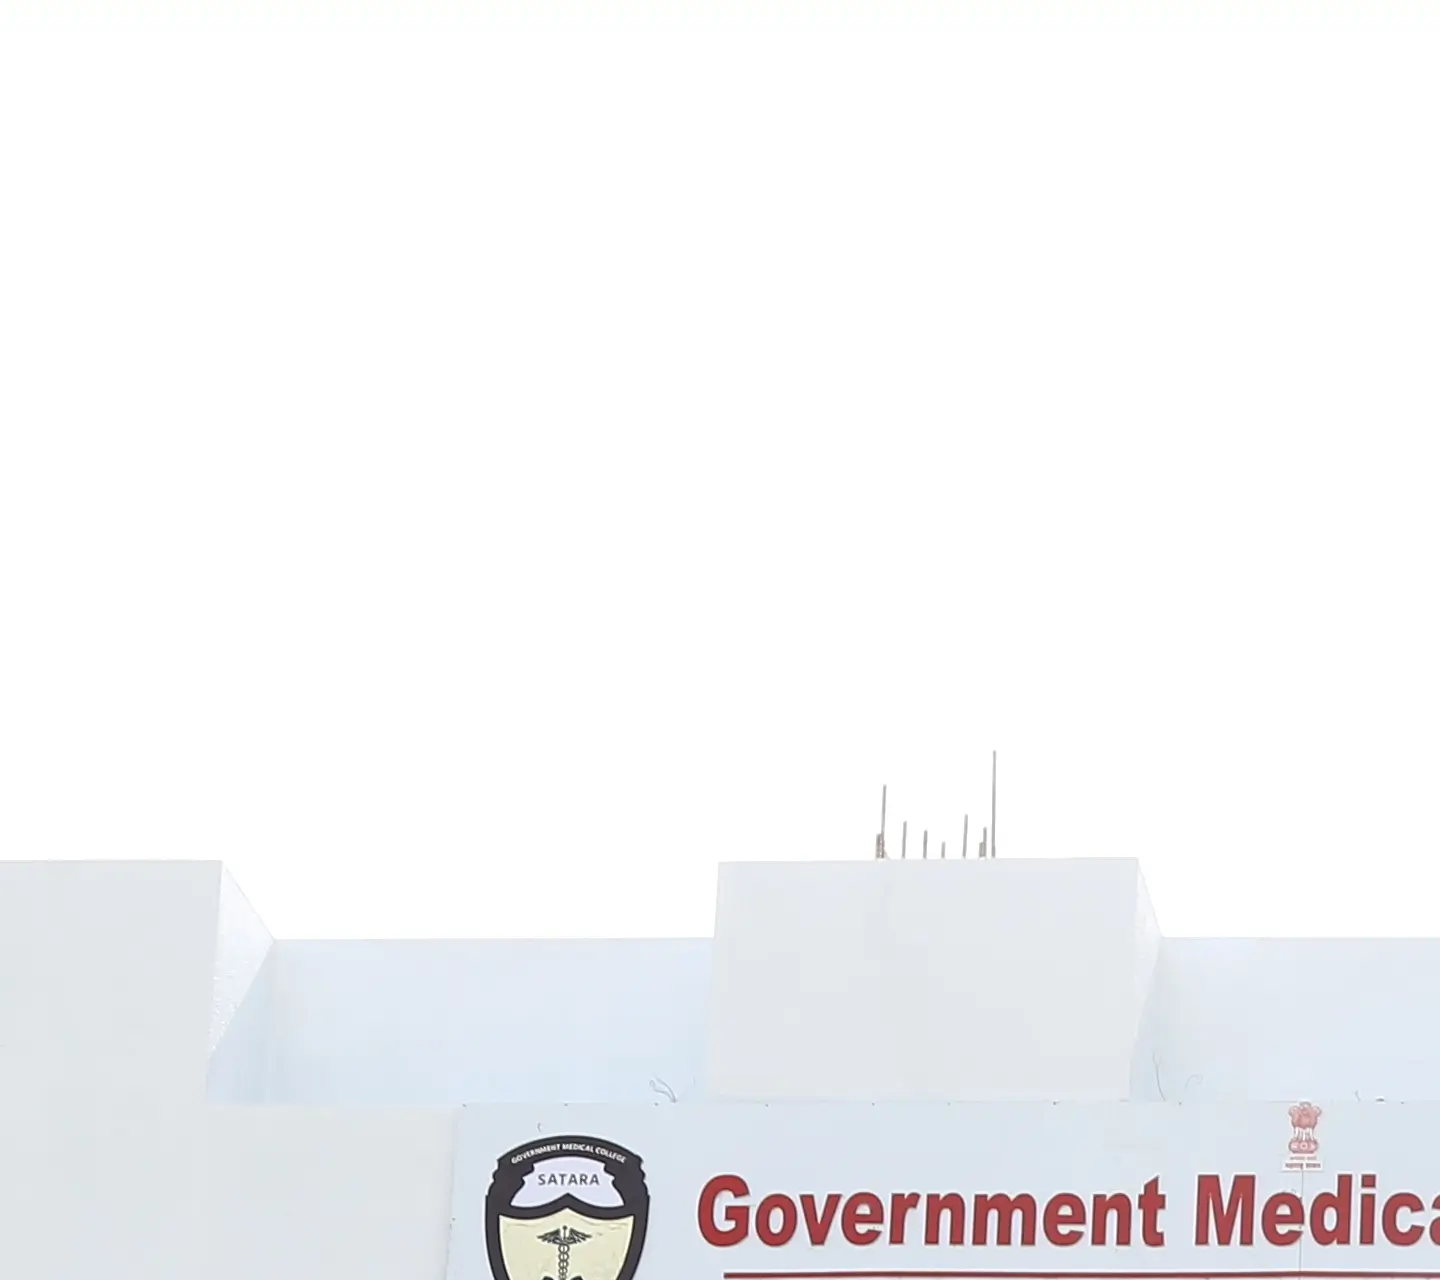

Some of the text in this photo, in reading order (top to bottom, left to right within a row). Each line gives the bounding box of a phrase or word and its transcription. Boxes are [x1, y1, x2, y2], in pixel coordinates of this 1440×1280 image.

[511, 1143, 627, 1164] GOVERNMENT MEDICAL COLLEGE
[538, 1173, 600, 1186] SATARA
[698, 1174, 1166, 1247] Government
